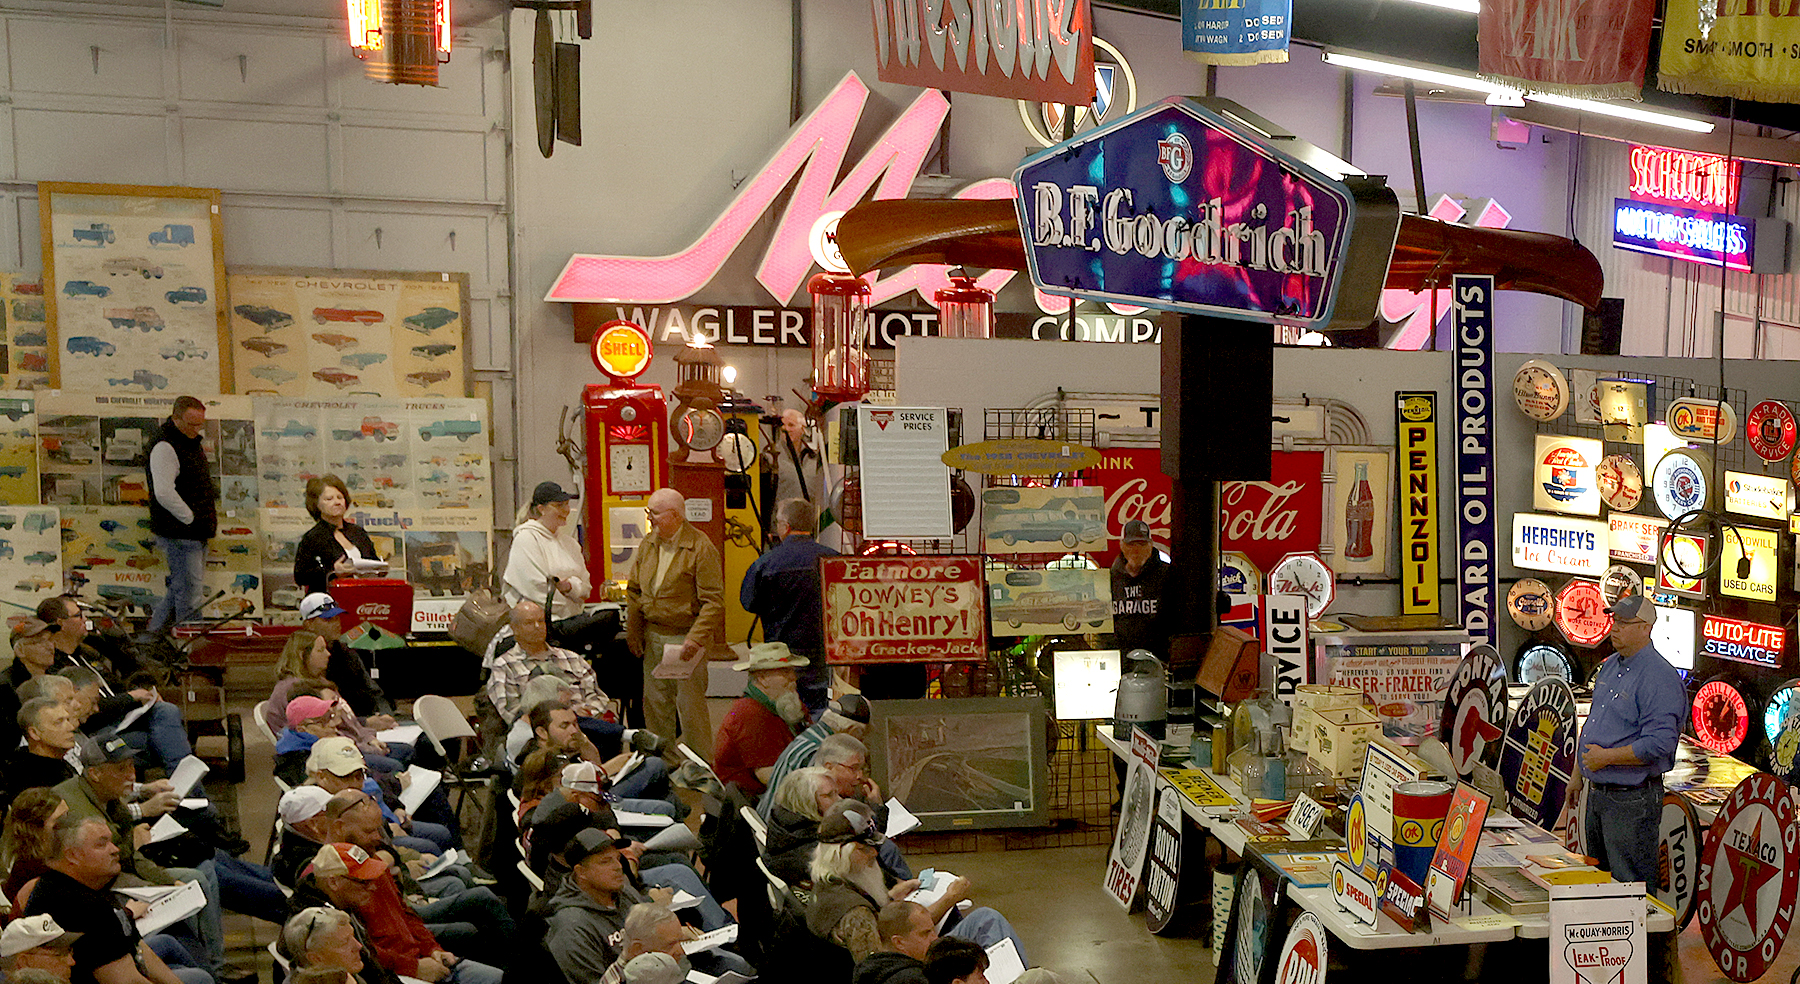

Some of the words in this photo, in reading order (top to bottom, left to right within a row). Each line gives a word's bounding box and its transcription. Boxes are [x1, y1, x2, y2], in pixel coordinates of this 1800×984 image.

[294, 279, 399, 293] CHEVROLET
[616, 306, 806, 346] WAGLER
[602, 341, 644, 360] SHELL
[1462, 284, 1486, 454] PRODUCTS
[294, 401, 358, 411] CHEVROLET
[404, 402, 446, 411] TRUCKS
[900, 412, 936, 422] SERVICE
[1749, 403, 1794, 432] TV-RADIO
[903, 421, 933, 432] PRICES
[1677, 411, 1689, 426] OK
[1750, 435, 1791, 459] SERVICE
[1463, 465, 1487, 525] OIL
[1407, 426, 1432, 607] PENNZOIL
[1611, 518, 1639, 533] BRAKE
[1521, 525, 1596, 552] HERSHEY'S
[1725, 533, 1774, 549] GOODWILL
[842, 560, 962, 582] Eatmore
[1523, 549, 1544, 562] Ice
[1546, 551, 1592, 569] Cream
[114, 572, 152, 583] VIKING
[1723, 579, 1748, 591] USED
[1749, 582, 1774, 596] CARS
[846, 585, 960, 610] LOWNEY'S
[1111, 599, 1158, 615] GARAGE
[840, 610, 876, 636] Oh
[877, 608, 970, 639] Henry!
[1704, 618, 1783, 648] AUTO-LITE
[870, 640, 981, 657] Cracker-Jack
[1354, 646, 1378, 656] START
[1387, 646, 1410, 656] YOUR
[1410, 646, 1430, 656] TRIP
[1704, 639, 1780, 663] SERVICE
[1697, 683, 1744, 712] SCHILLING
[1698, 729, 1740, 752] COFFEE
[1718, 778, 1797, 854] TEXACO
[1350, 809, 1364, 855] OK
[1404, 824, 1420, 839] OK
[1154, 823, 1180, 875] ROYAL
[1732, 828, 1777, 864] TEXACO
[1669, 815, 1688, 911] TYDOL
[1109, 861, 1136, 903] TIRES
[1148, 861, 1177, 914] TRITON
[1345, 881, 1374, 913] SPECIAL
[1698, 863, 1749, 978] MOTOR
[1762, 903, 1793, 962] OIL
